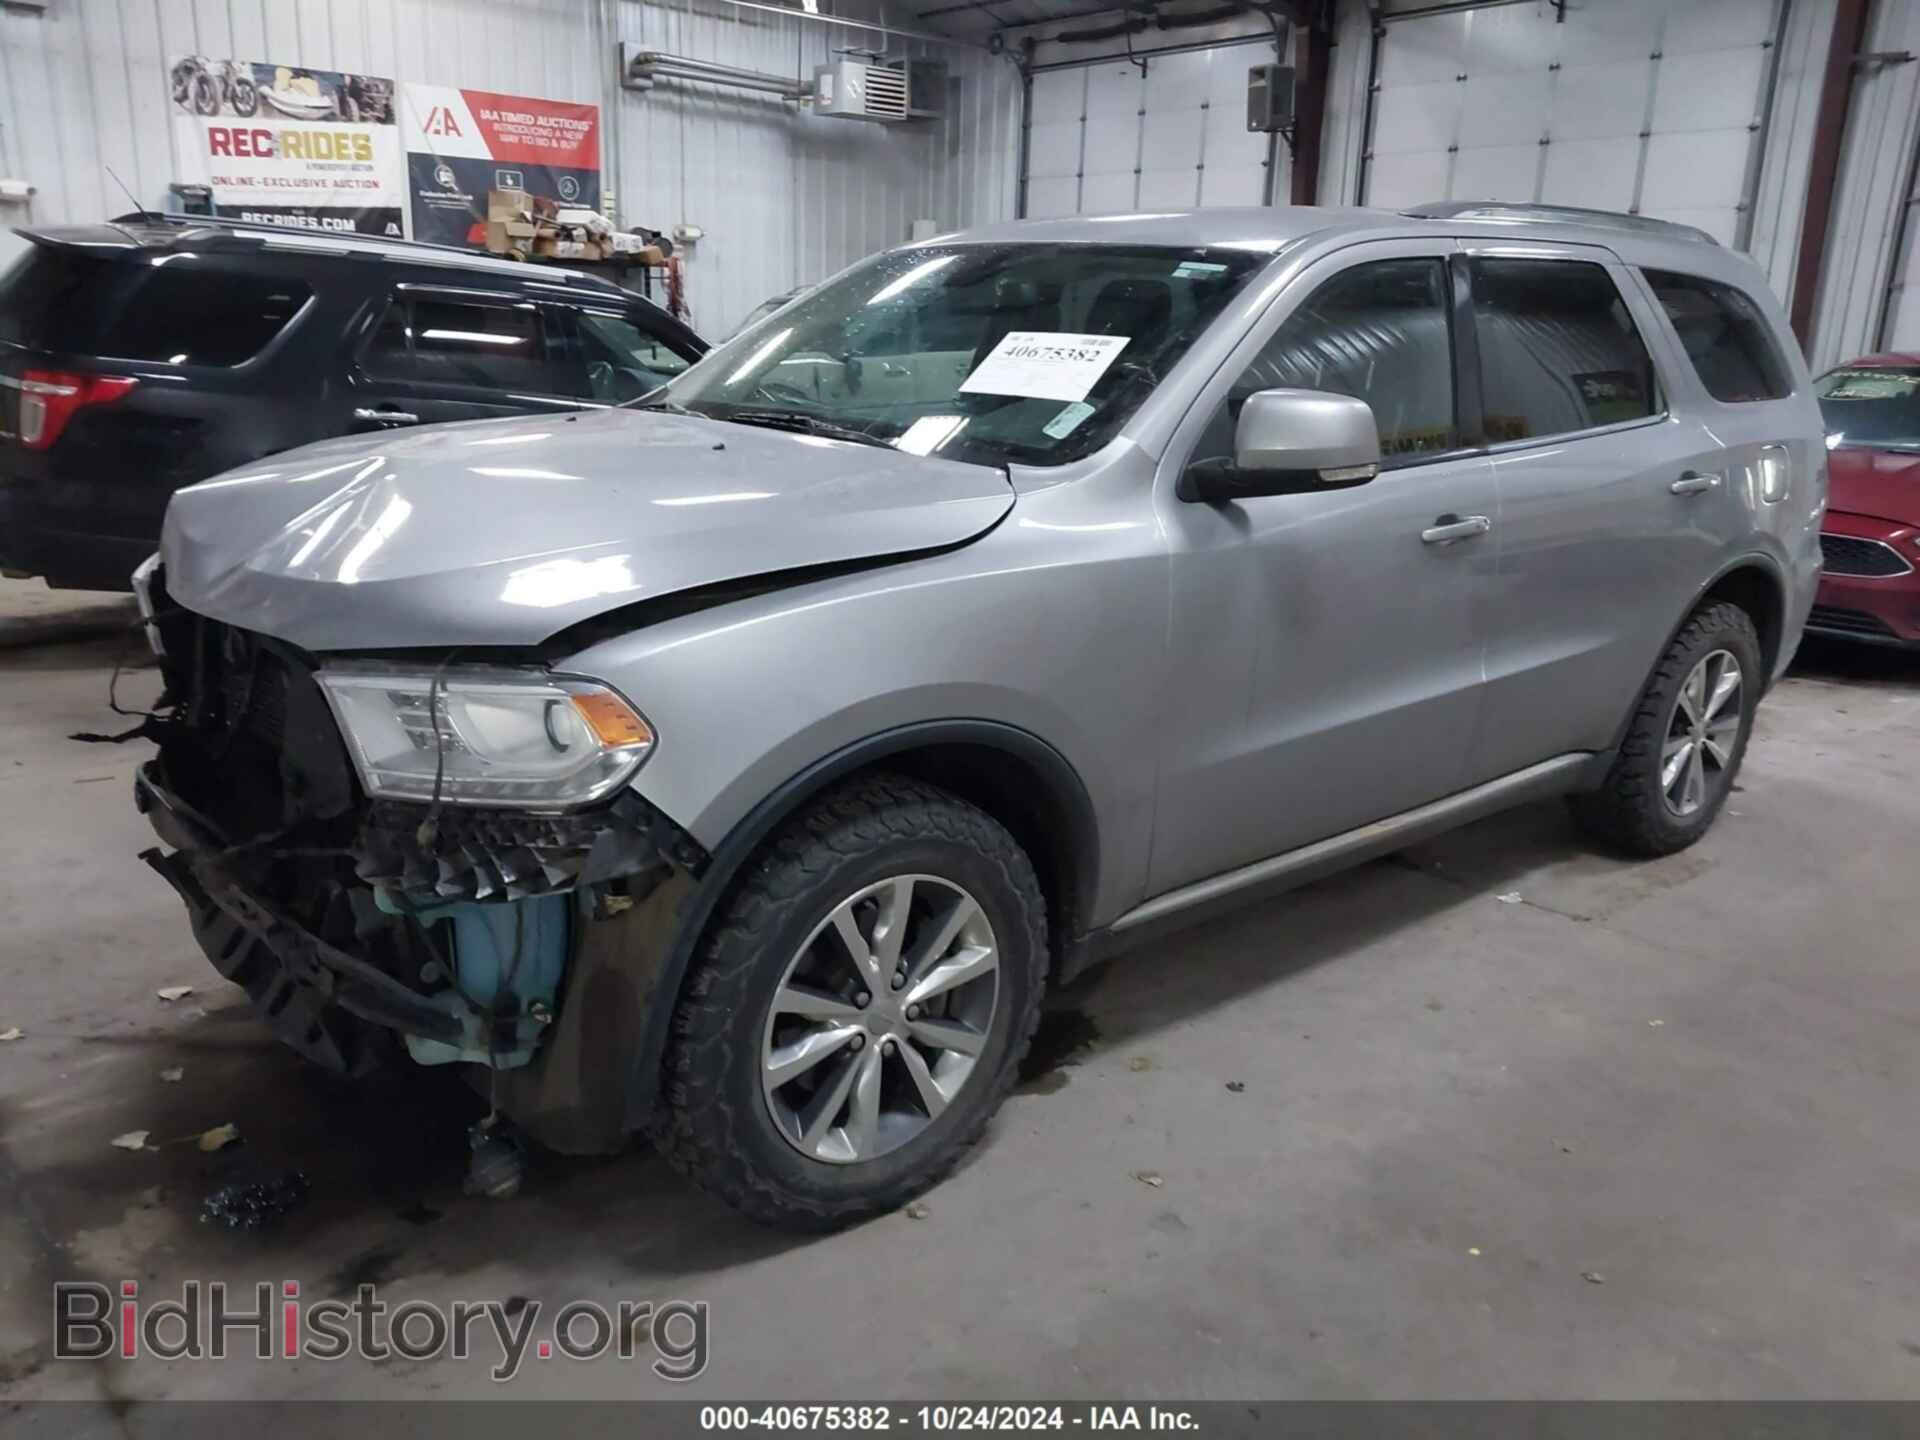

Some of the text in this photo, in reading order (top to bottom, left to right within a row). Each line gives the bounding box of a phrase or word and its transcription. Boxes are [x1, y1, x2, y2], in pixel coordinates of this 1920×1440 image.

[500, 112, 534, 125] TIMED
[493, 122, 552, 137] INTRODUCING
[562, 130, 584, 140] NEW
[279, 130, 373, 161] RIDES
[499, 133, 519, 143] WAY
[521, 135, 533, 144] TO
[535, 137, 549, 147] BID
[560, 139, 577, 150] BUY
[212, 176, 380, 189] ONLINE-EXCLUSIVE AUCTION
[242, 212, 355, 231] RECRIDES.COM
[1003, 345, 1101, 362] 40675382
